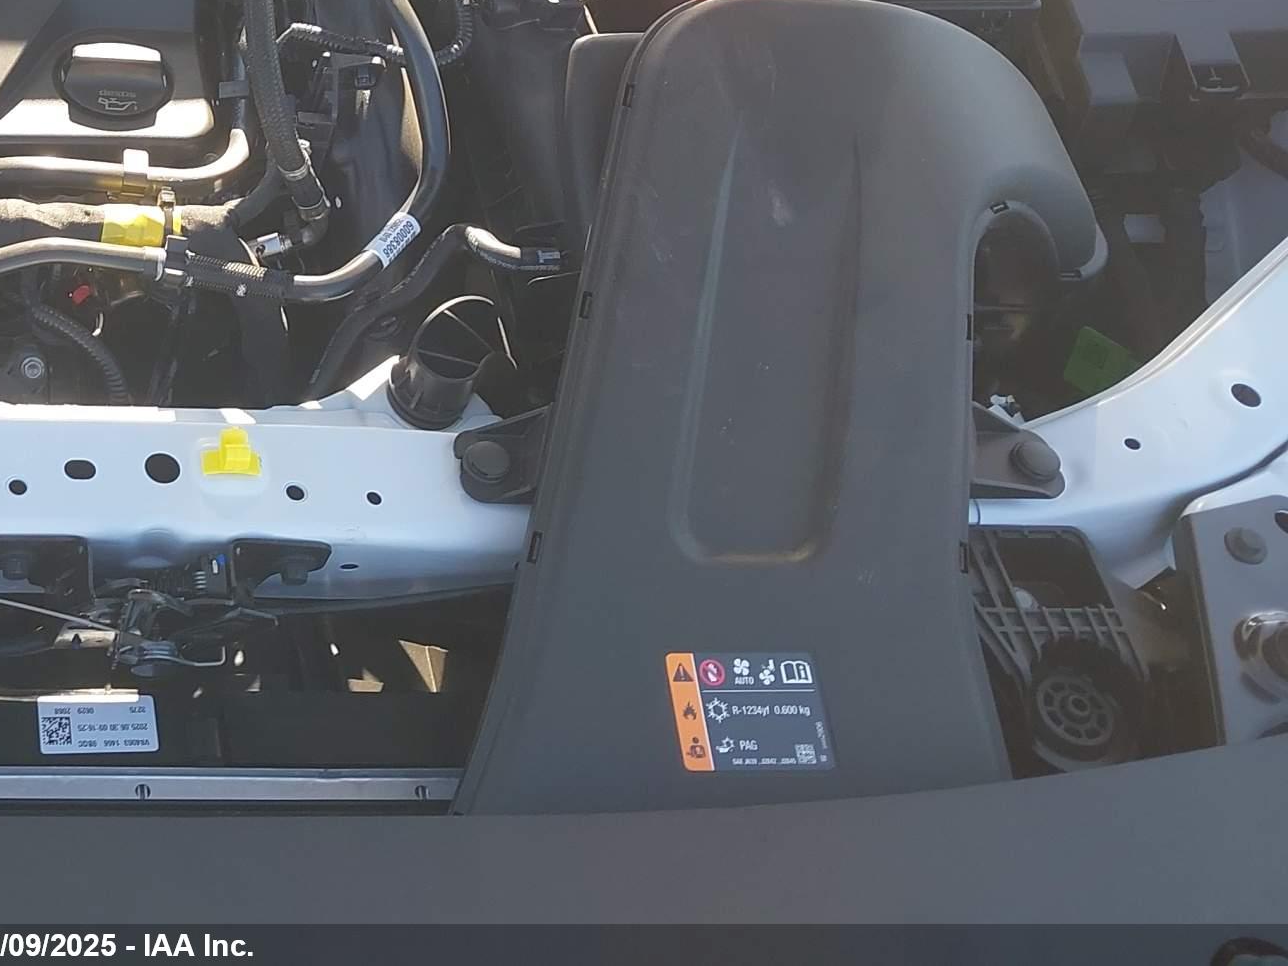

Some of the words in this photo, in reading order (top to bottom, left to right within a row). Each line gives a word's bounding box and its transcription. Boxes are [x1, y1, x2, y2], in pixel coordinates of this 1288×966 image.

[734, 676, 755, 685] AUTO
[732, 705, 770, 717] R-1234yf
[774, 705, 798, 715] 0.600
[799, 705, 811, 717] kg
[739, 740, 758, 751] PAG
